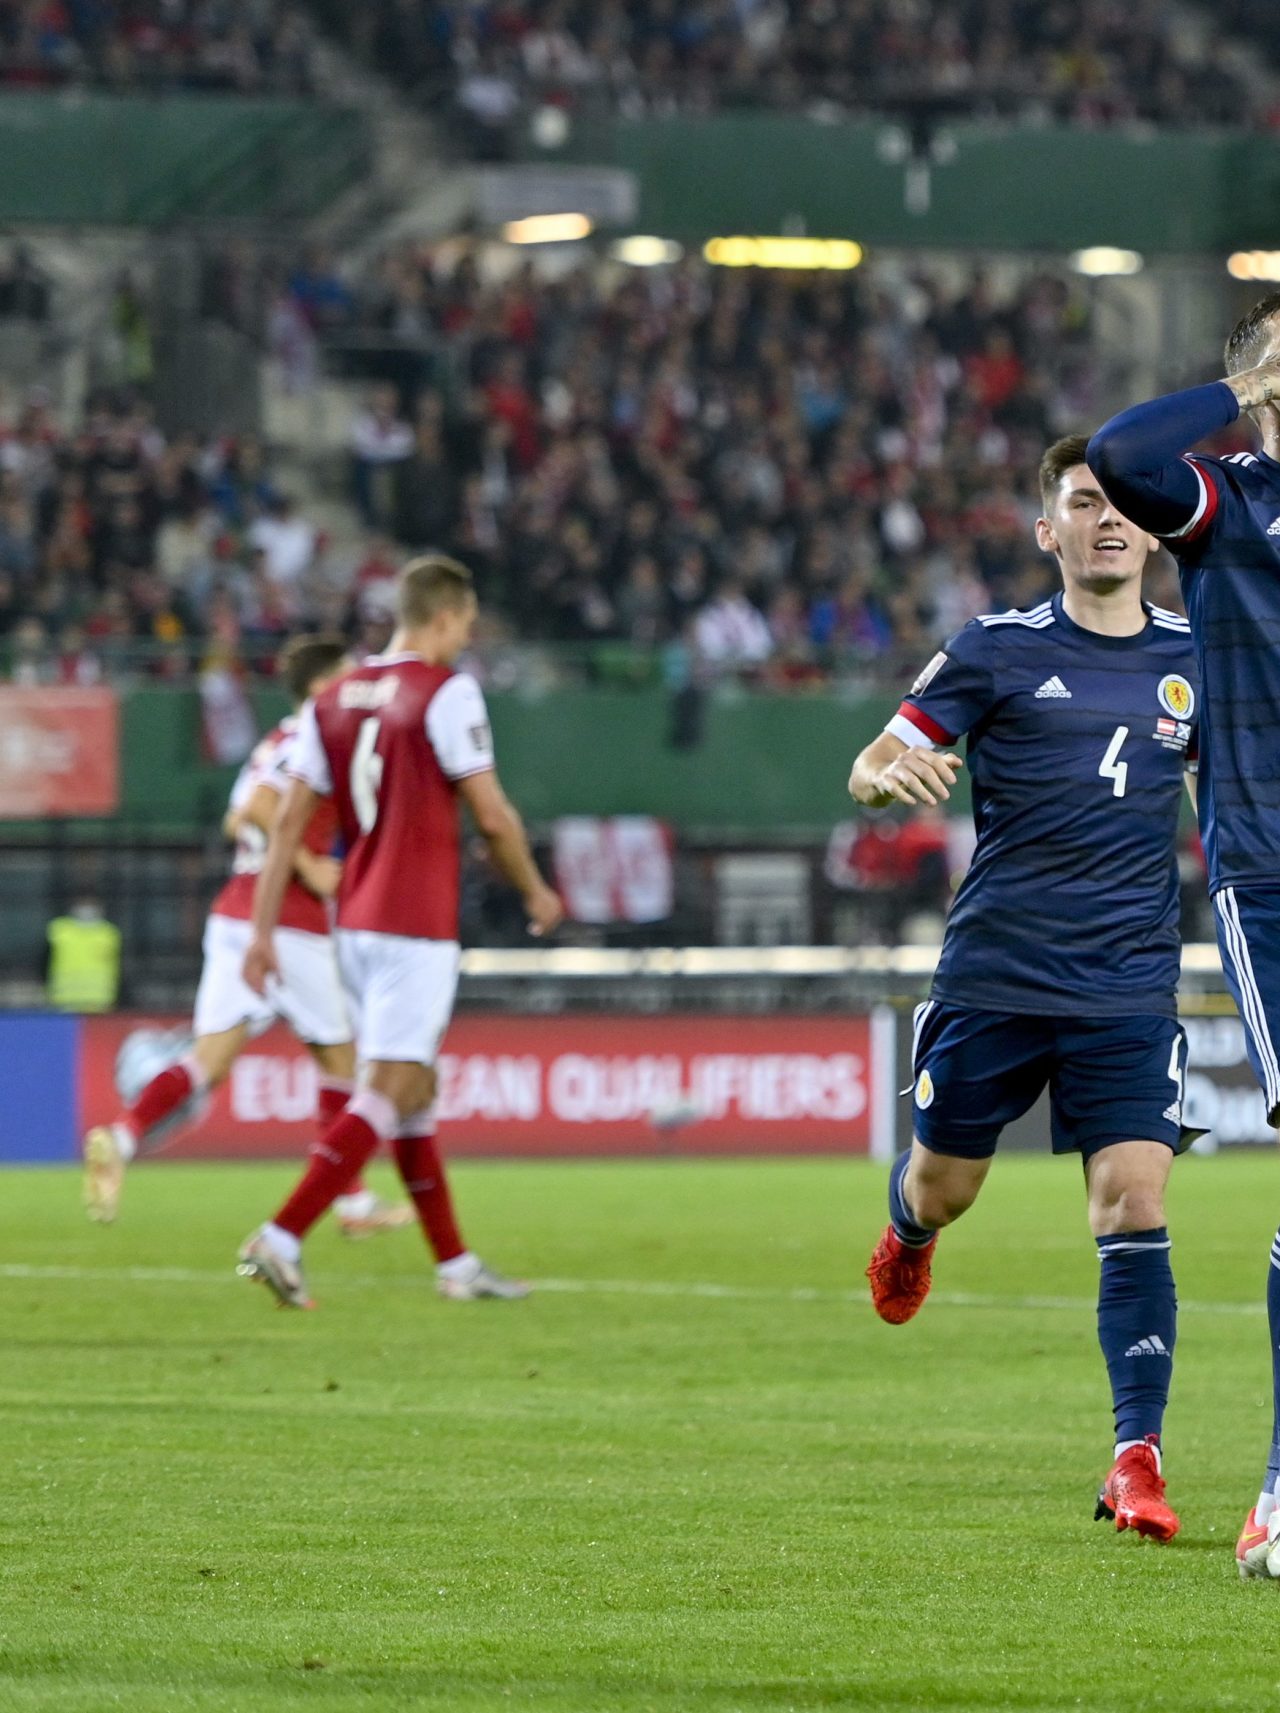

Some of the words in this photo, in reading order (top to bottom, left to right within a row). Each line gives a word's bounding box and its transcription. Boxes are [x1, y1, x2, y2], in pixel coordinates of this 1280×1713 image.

[1034, 689, 1072, 699] adidas
[351, 715, 384, 835] 6
[1098, 725, 1129, 798] 4
[230, 1054, 543, 1122] EUEAN
[548, 1053, 868, 1122] QUALIFIERS
[1124, 1348, 1171, 1357] adidas
